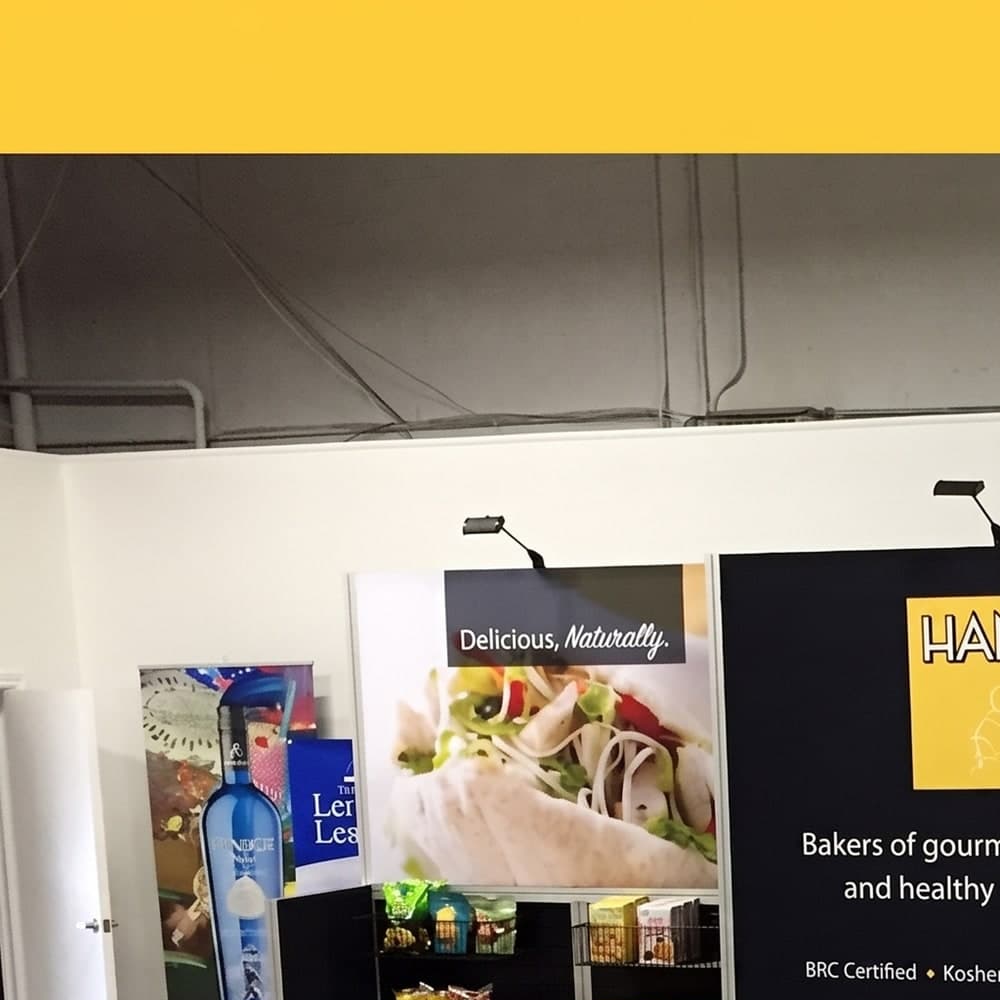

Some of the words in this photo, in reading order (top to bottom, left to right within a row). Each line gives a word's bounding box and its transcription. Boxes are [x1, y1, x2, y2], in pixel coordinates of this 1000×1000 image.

[460, 628, 559, 652] Delicious,
[564, 623, 669, 661] Naturally.
[802, 831, 883, 857] Bakers
[891, 831, 918, 857] of
[844, 874, 891, 900] and
[899, 874, 995, 907] healthy
[805, 961, 840, 979] BRC
[843, 961, 917, 981] Certified
